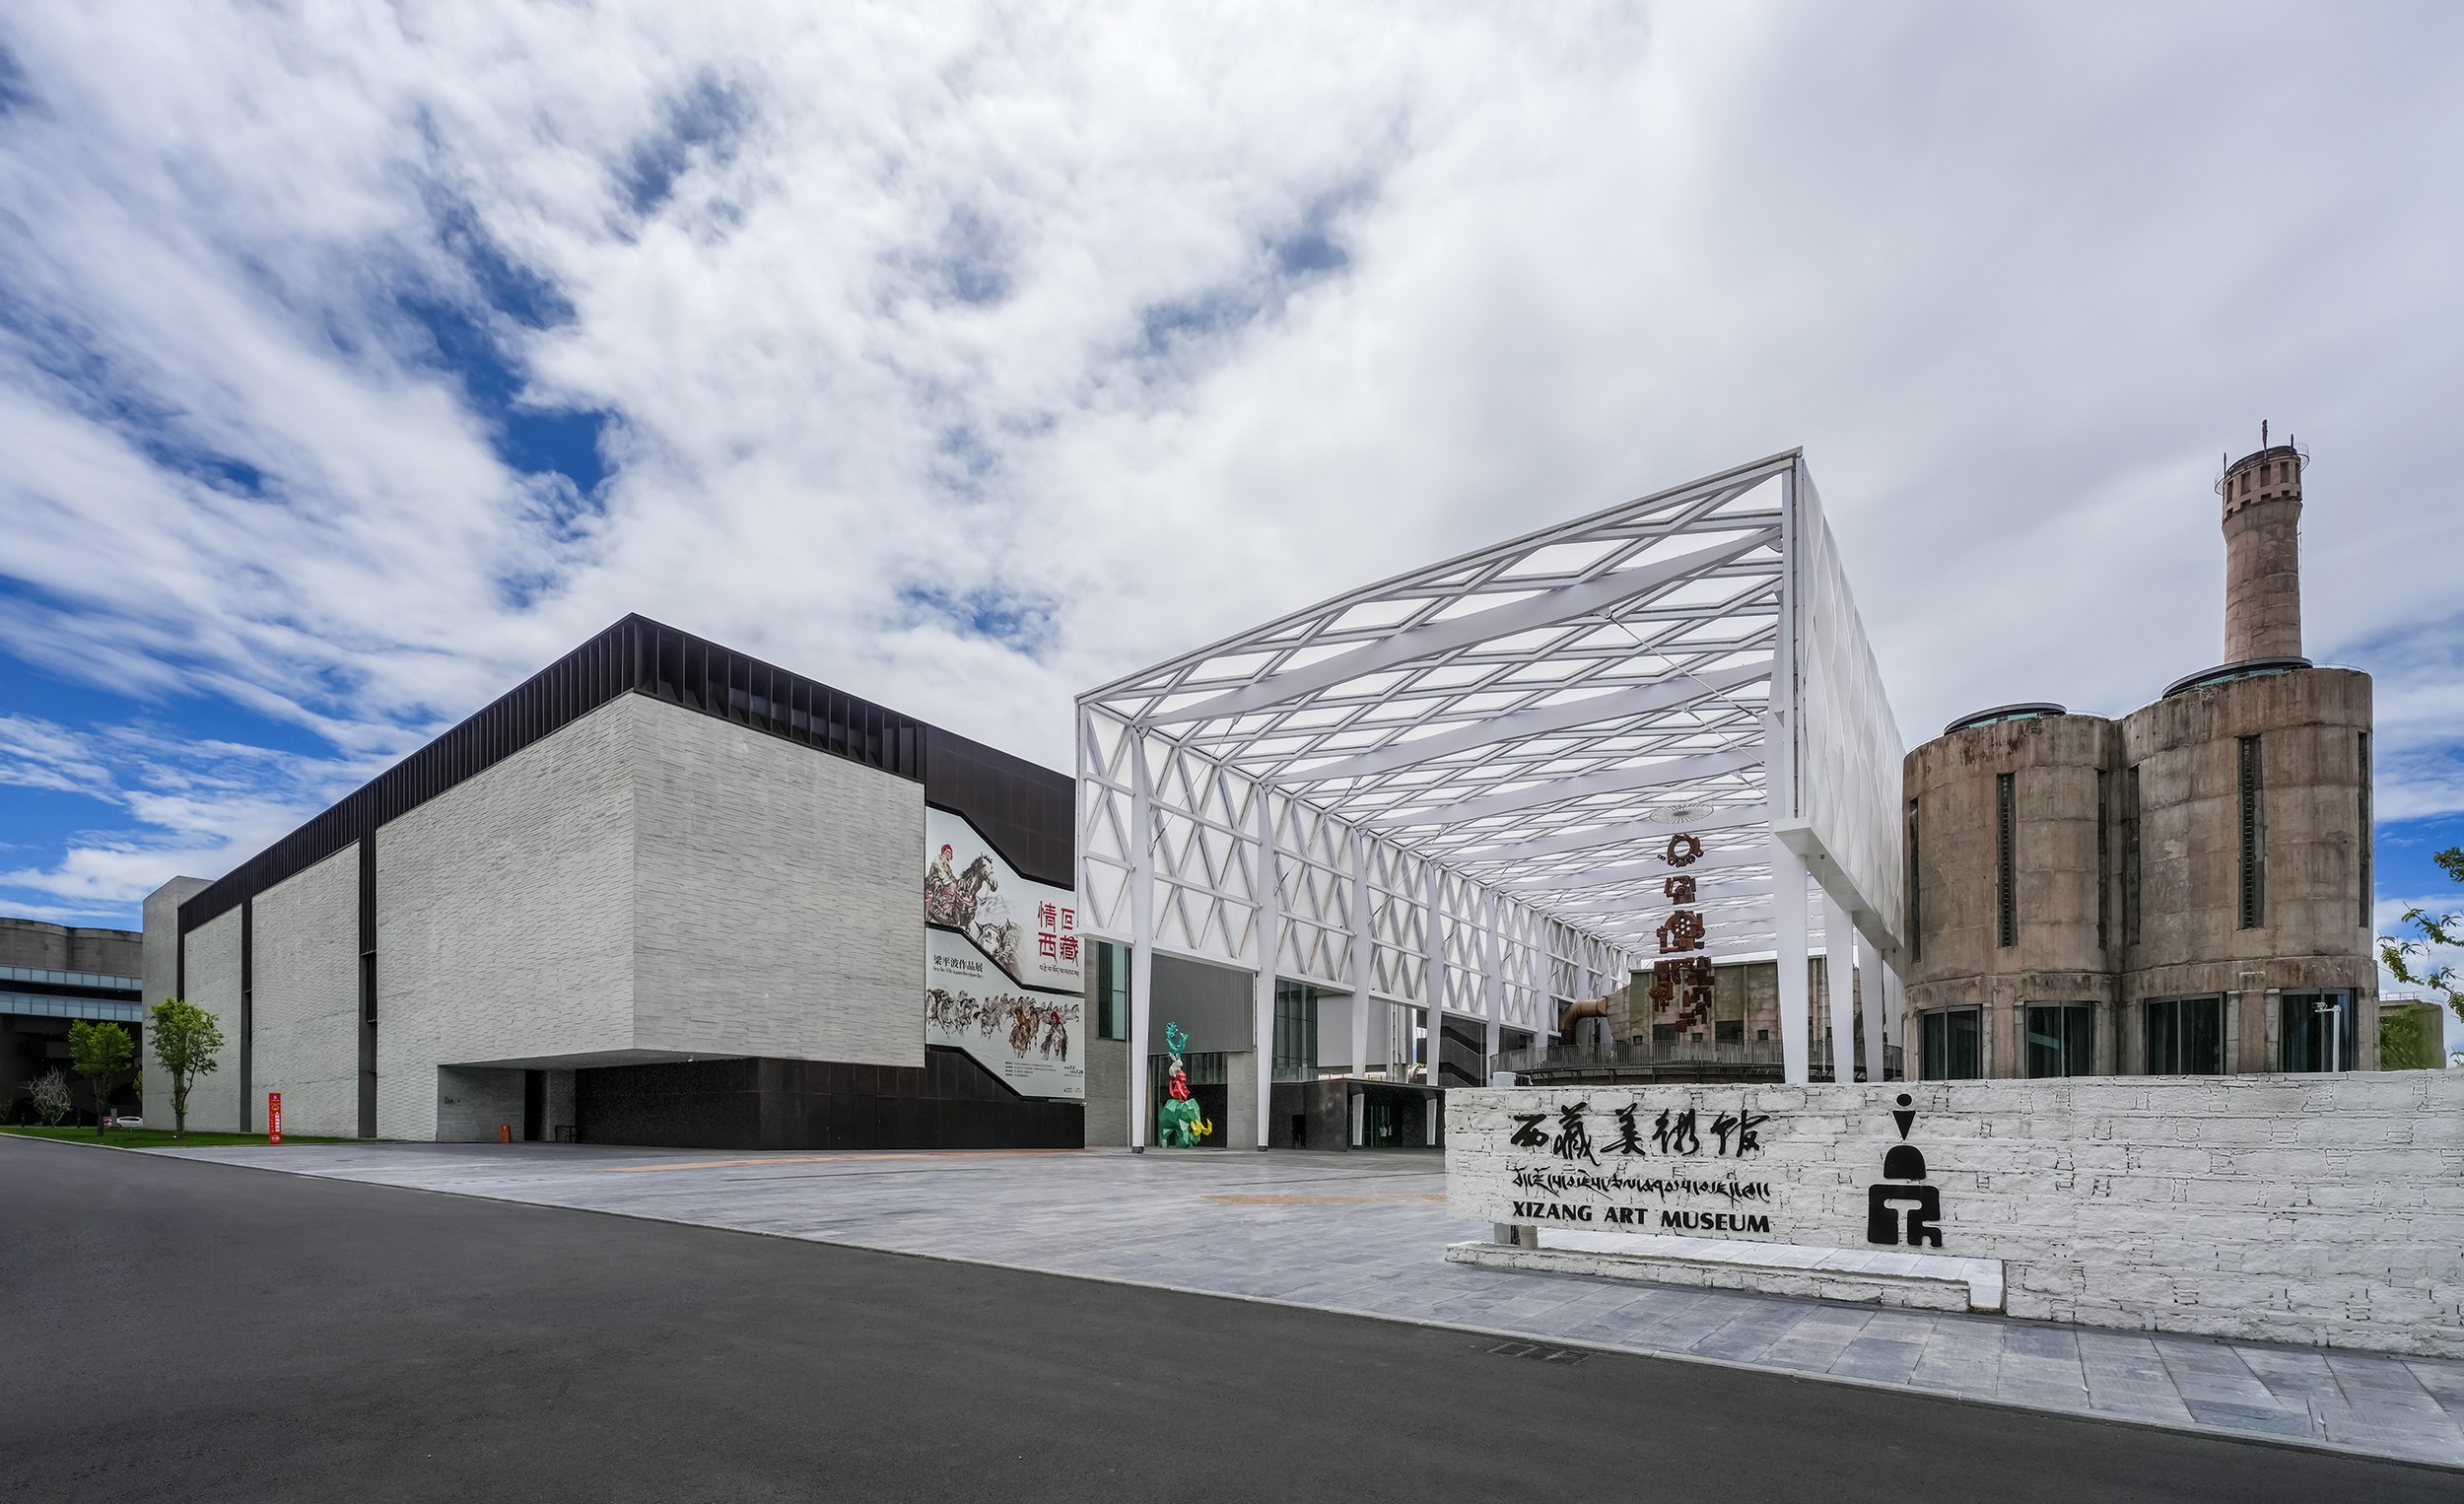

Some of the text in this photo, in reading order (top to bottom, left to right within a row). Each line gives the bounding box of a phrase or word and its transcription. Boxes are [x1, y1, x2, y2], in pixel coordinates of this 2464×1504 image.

[932, 954, 984, 973] 梁平波作品展
[1512, 1200, 1770, 1233] XIZANG ART MUSEUM
